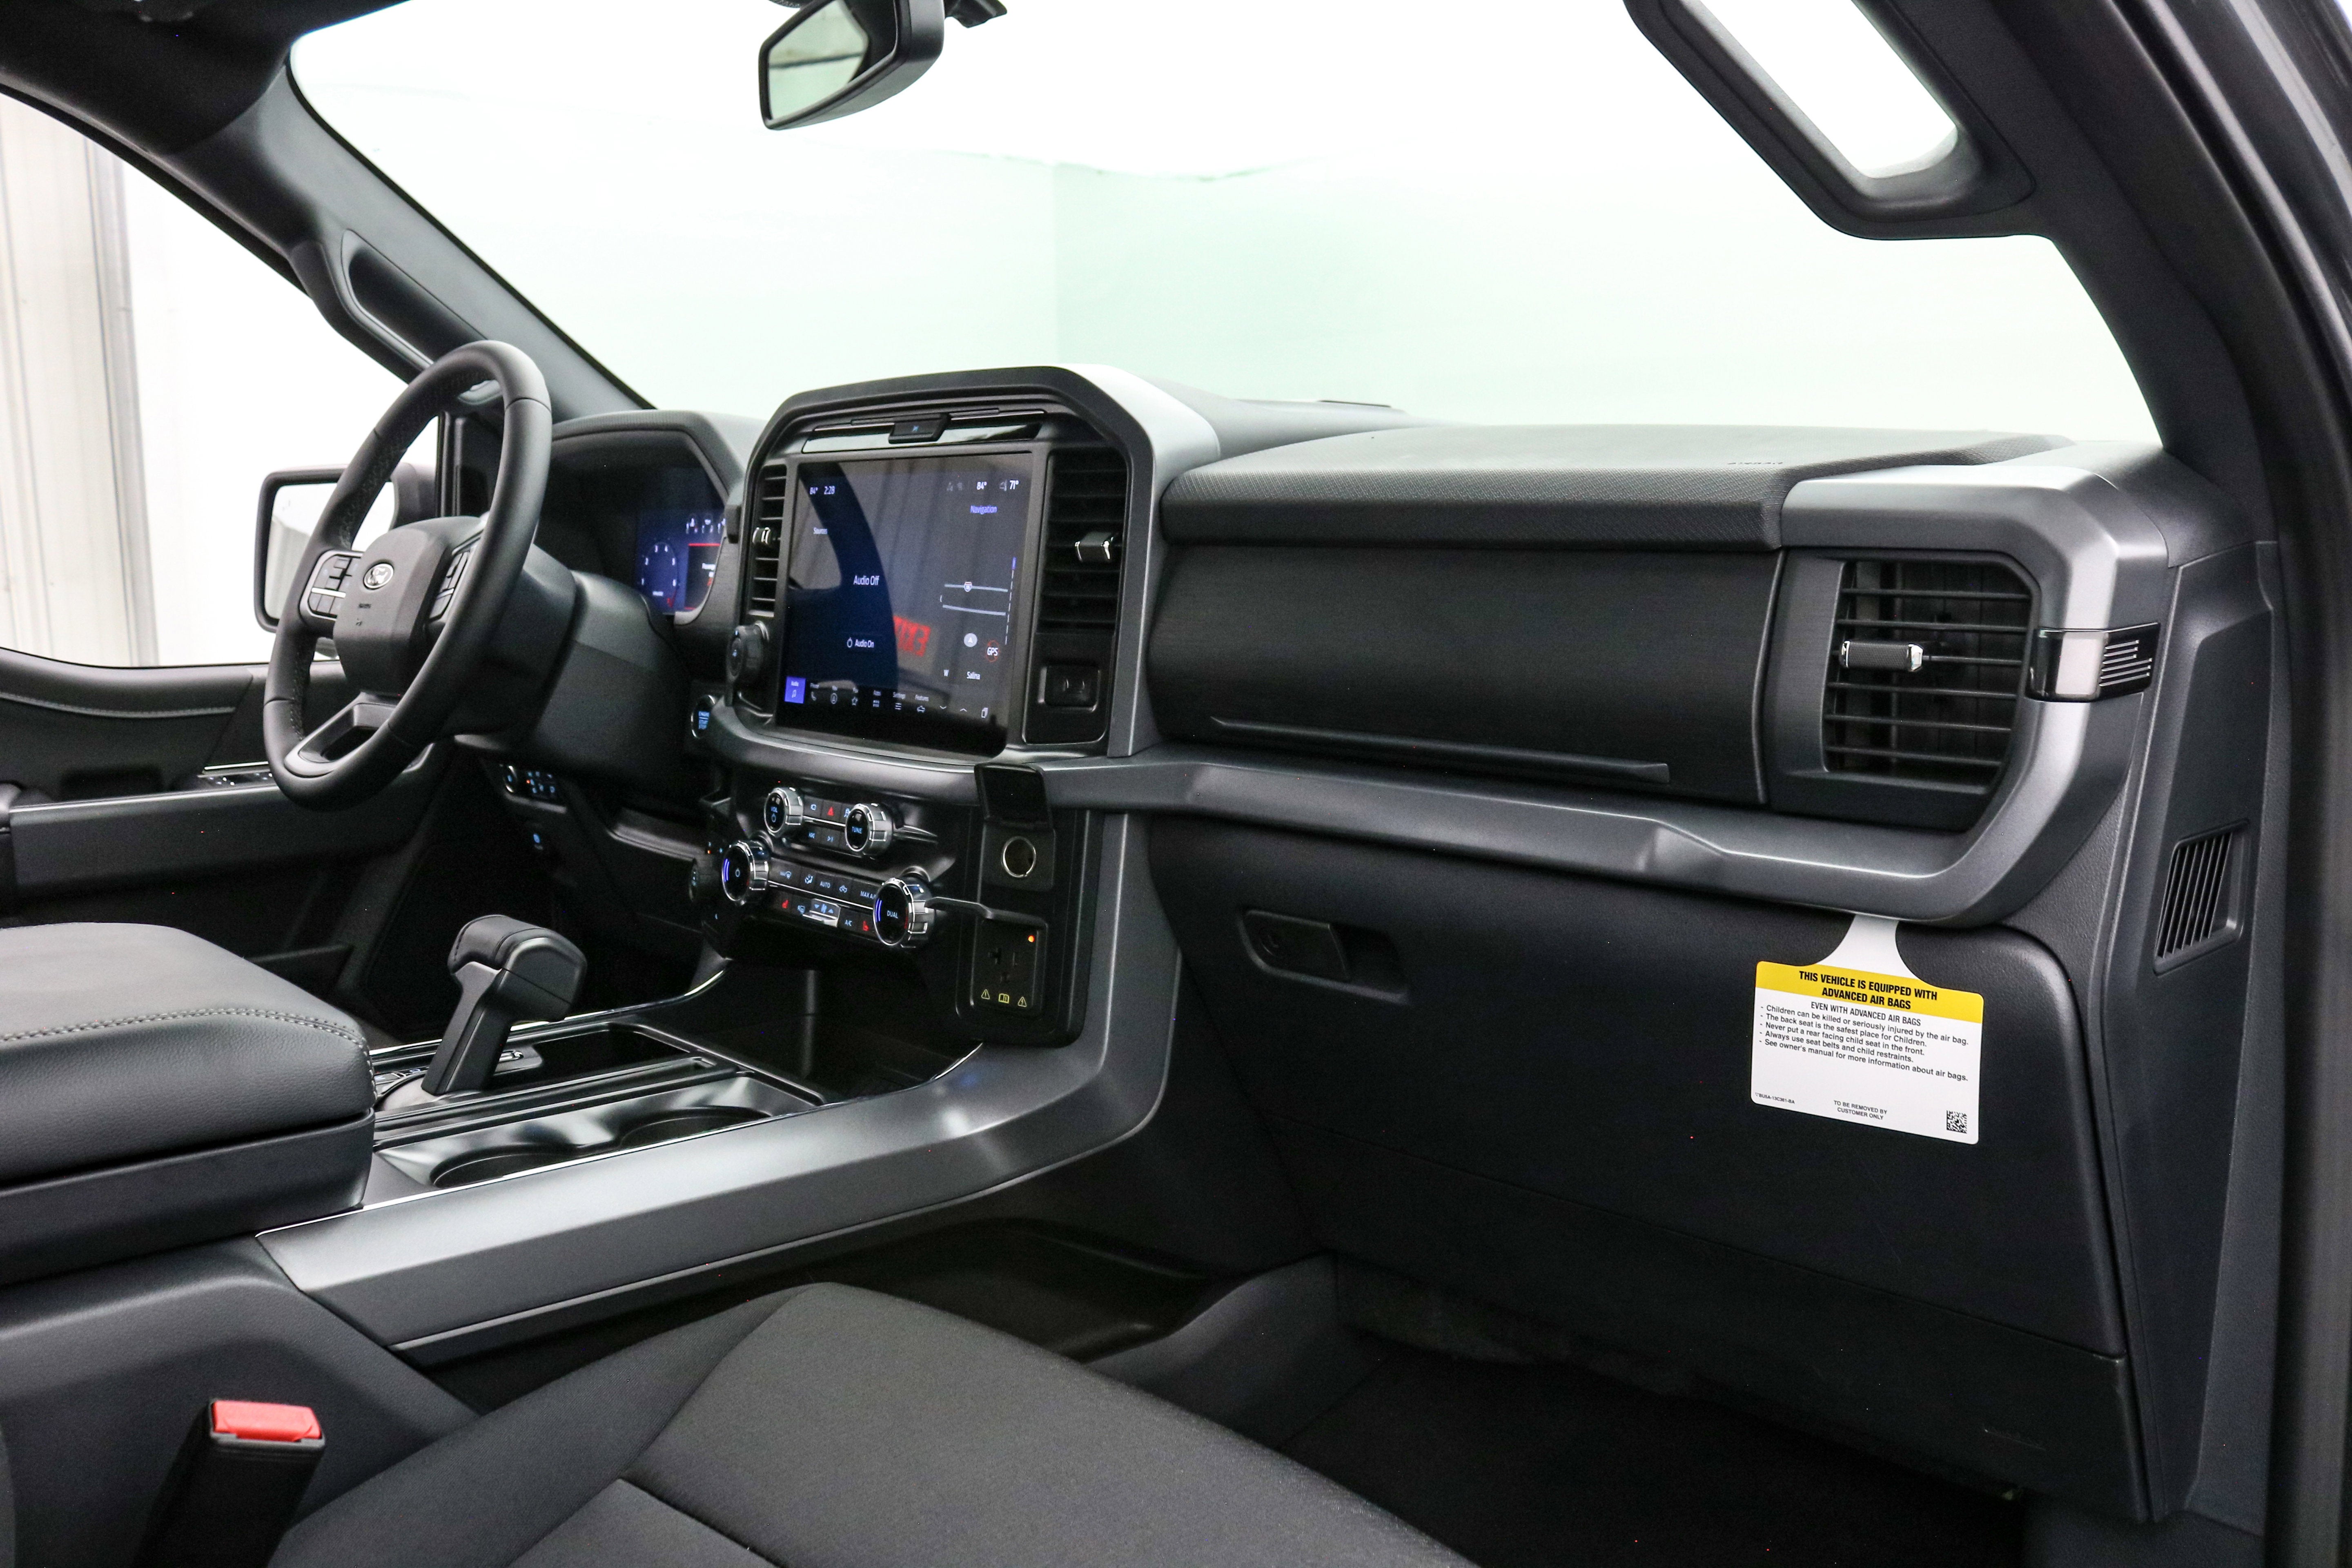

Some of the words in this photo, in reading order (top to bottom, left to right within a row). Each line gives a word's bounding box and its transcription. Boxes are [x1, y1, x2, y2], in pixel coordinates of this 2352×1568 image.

[970, 505, 997, 514] Navigation
[853, 575, 869, 585] Audio
[870, 575, 880, 586] Off
[855, 639, 867, 647] Audio
[868, 640, 874, 648] On
[987, 647, 998, 656] GPS
[887, 910, 898, 919] DUAL
[1799, 971, 1818, 982] THIS
[1820, 974, 1855, 987] VEHICLE
[1858, 980, 1866, 989] IS
[1869, 981, 1911, 996] EQUIPPED
[1914, 989, 1937, 1000] WITH
[1822, 987, 1867, 1002] ADVANCED
[1870, 995, 1884, 1005] AIR
[1887, 998, 1911, 1009] BAGS
[1766, 1004, 1795, 1016] Children
[1822, 1014, 1841, 1023] killed
[1852, 1020, 1886, 1032] seriously
[1888, 1025, 1913, 1036] injured
[1915, 1029, 1924, 1039] by
[1952, 1036, 1968, 1046] bag.
[1811, 1001, 1828, 1011] EVEN
[1830, 1004, 1848, 1014] WITH
[1849, 1008, 1886, 1020] ADVANCED
[1888, 1014, 1900, 1023] AIR
[1902, 1016, 1921, 1027] BAGS
[1766, 1013, 1779, 1021] The
[1780, 1016, 1797, 1025] back
[1836, 1027, 1858, 1035] safest
[1860, 1030, 1879, 1038] place
[1893, 1035, 1927, 1047] Children.
[1766, 1021, 1786, 1031] Never
[1822, 1031, 1844, 1043] facing
[1846, 1036, 1863, 1045] child
[1891, 1044, 1903, 1052] the
[1905, 1046, 1924, 1056] front.
[1765, 1030, 1790, 1041] Always
[1822, 1040, 1840, 1049] belts
[1857, 1047, 1875, 1056] child
[1877, 1051, 1913, 1062] restraints.
[1765, 1038, 1777, 1047] See
[1779, 1042, 1806, 1052] owner's
[1808, 1048, 1834, 1057] manual
[1848, 1055, 1866, 1063] more
[1868, 1057, 1910, 1071] information
[1912, 1066, 1933, 1075] about
[1947, 1071, 1968, 1081] bags.
[1837, 1107, 1868, 1117] CUSTOMER
[1851, 1103, 1878, 1113] REMOVED
